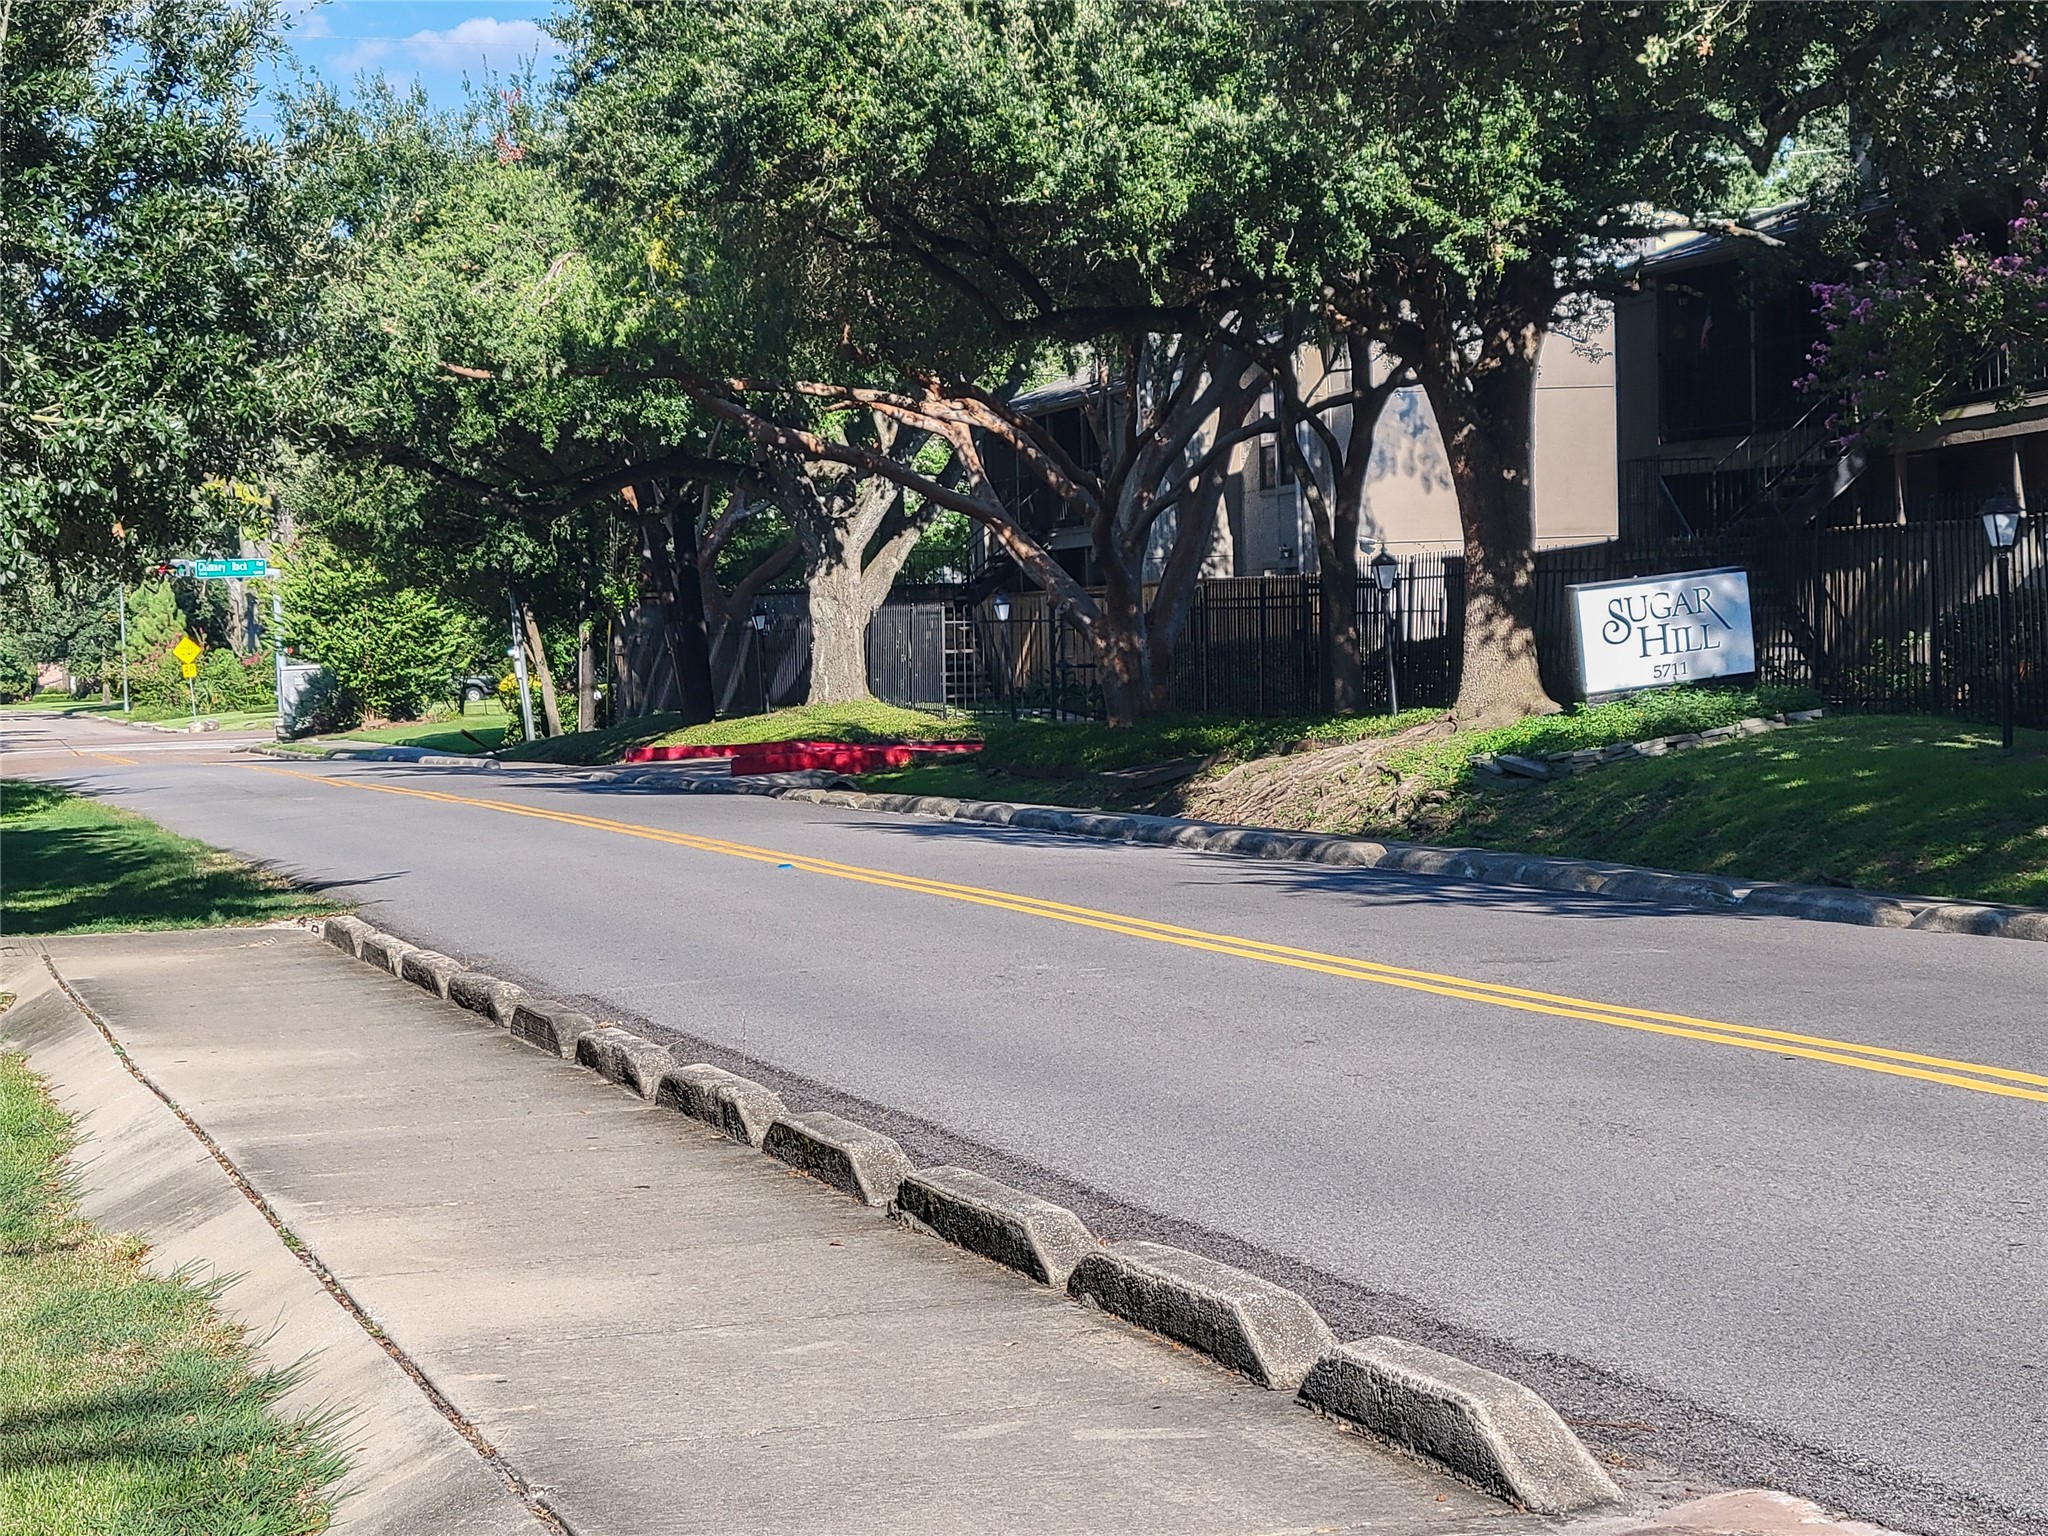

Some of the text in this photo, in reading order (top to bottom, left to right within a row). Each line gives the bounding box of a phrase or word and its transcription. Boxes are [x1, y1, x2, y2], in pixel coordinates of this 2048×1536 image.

[231, 561, 248, 571] Rock
[1602, 585, 1734, 645] SUGAR
[1636, 622, 1722, 659] HILL
[1653, 661, 1689, 679] 5711
